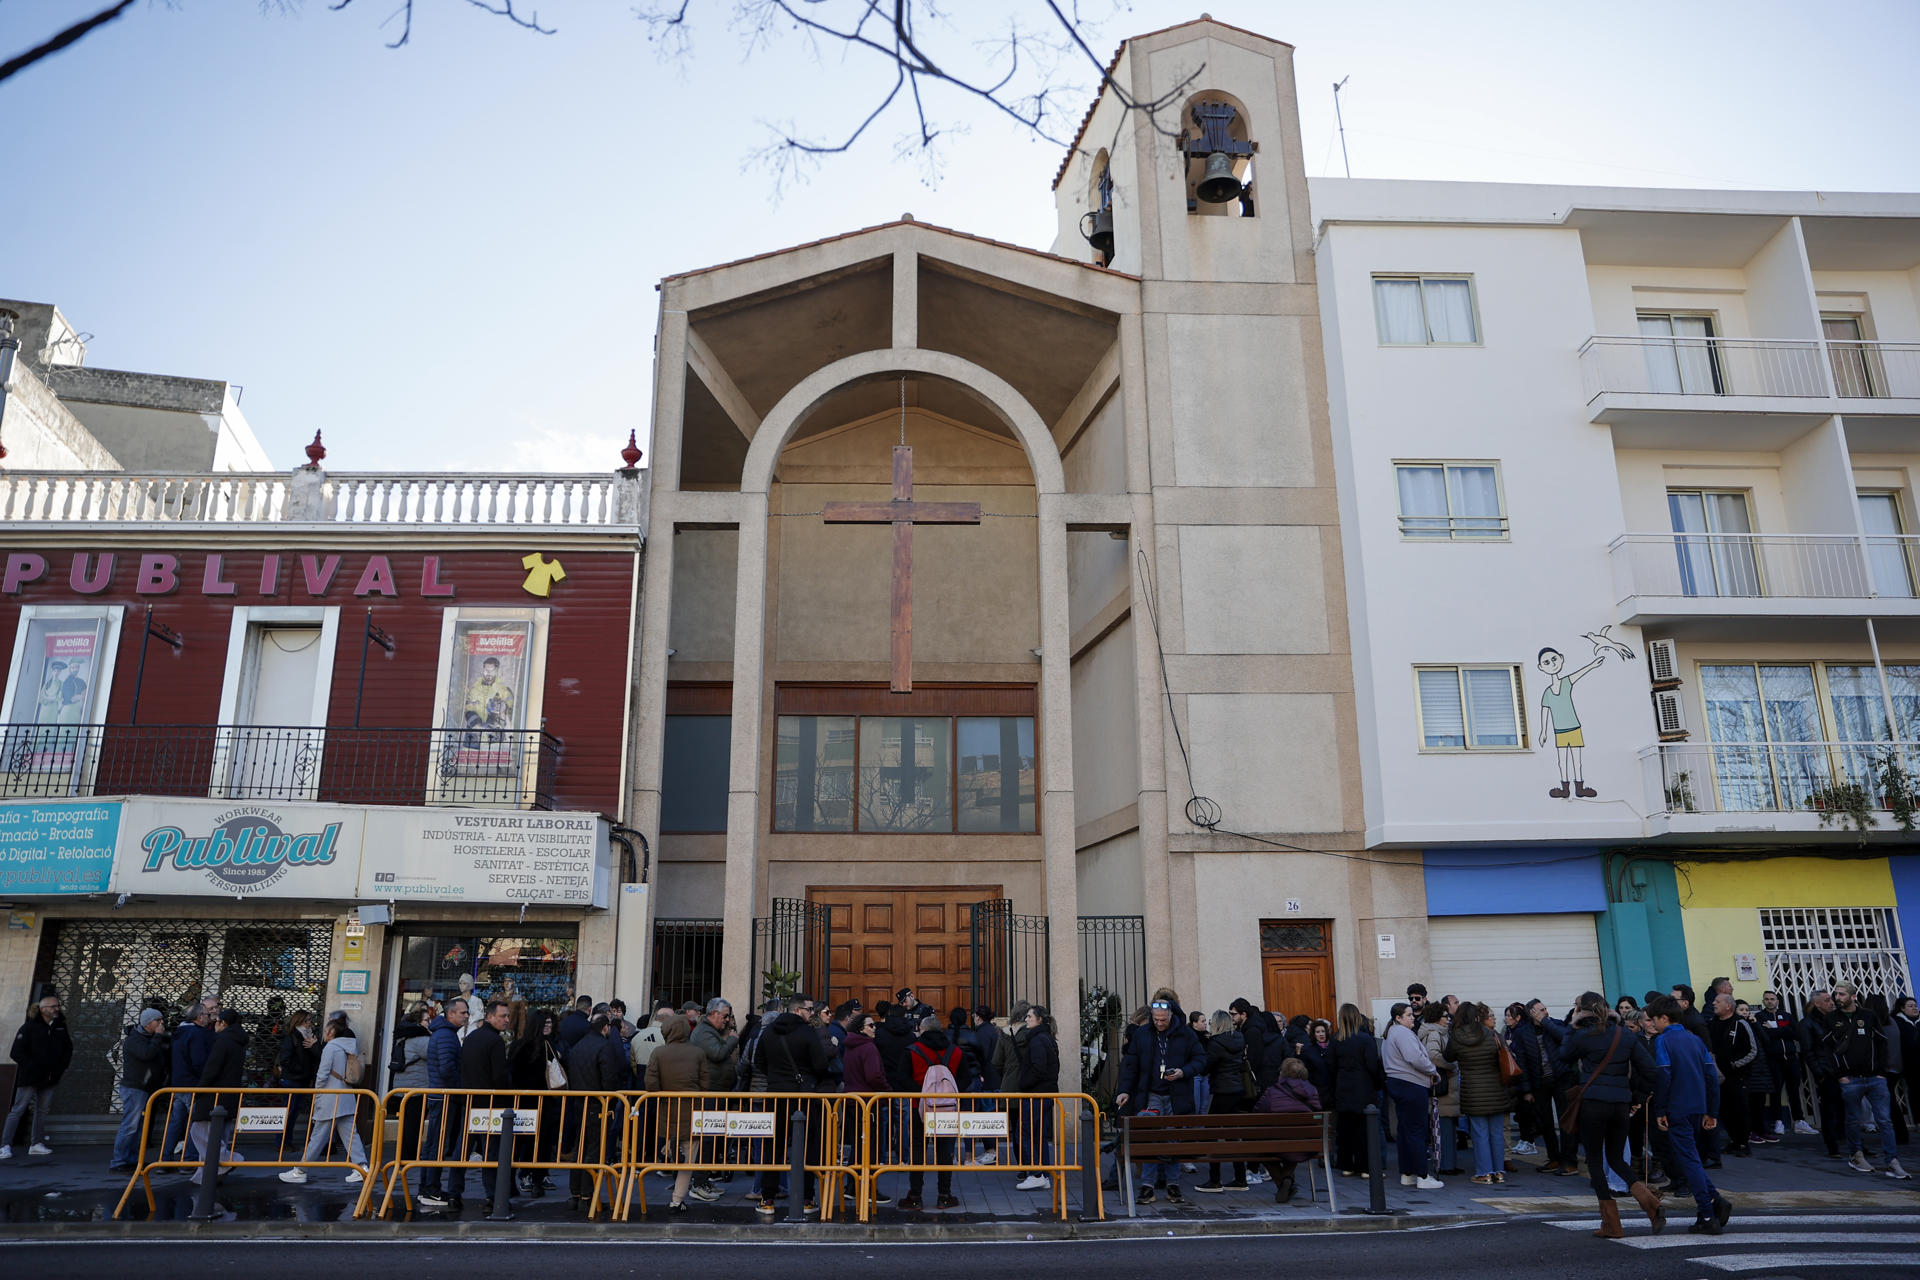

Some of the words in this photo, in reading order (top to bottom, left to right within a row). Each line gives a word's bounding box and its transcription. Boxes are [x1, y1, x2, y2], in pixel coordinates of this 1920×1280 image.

[1, 552, 457, 597] PUBLIVAL
[32, 807, 109, 825] Tampografia
[214, 806, 283, 825] WORKWEAR
[454, 816, 523, 828] VESTUARI
[526, 819, 593, 831] LABORAL
[49, 826, 94, 841] Brodats
[422, 828, 486, 841] INDÚSTRIA
[495, 832, 525, 843] ALTA
[527, 833, 592, 845] VISIBILITAT
[8, 846, 48, 863] Digital
[57, 845, 112, 860] Retolació
[141, 822, 343, 873] Publival
[453, 845, 527, 857] HOSTELERIA
[536, 847, 591, 859] ESCOLAR
[222, 867, 247, 876] Since
[247, 868, 267, 876] 1985
[473, 859, 525, 870] SANITAT
[204, 866, 288, 894] PERSONALIZING
[488, 873, 537, 885] SERVEIS
[545, 875, 589, 888] NETEJA
[374, 883, 465, 895] www.publival.es
[505, 888, 555, 900] CALÇAT
[563, 889, 589, 900] EPIS
[1287, 901, 1299, 911] 26
